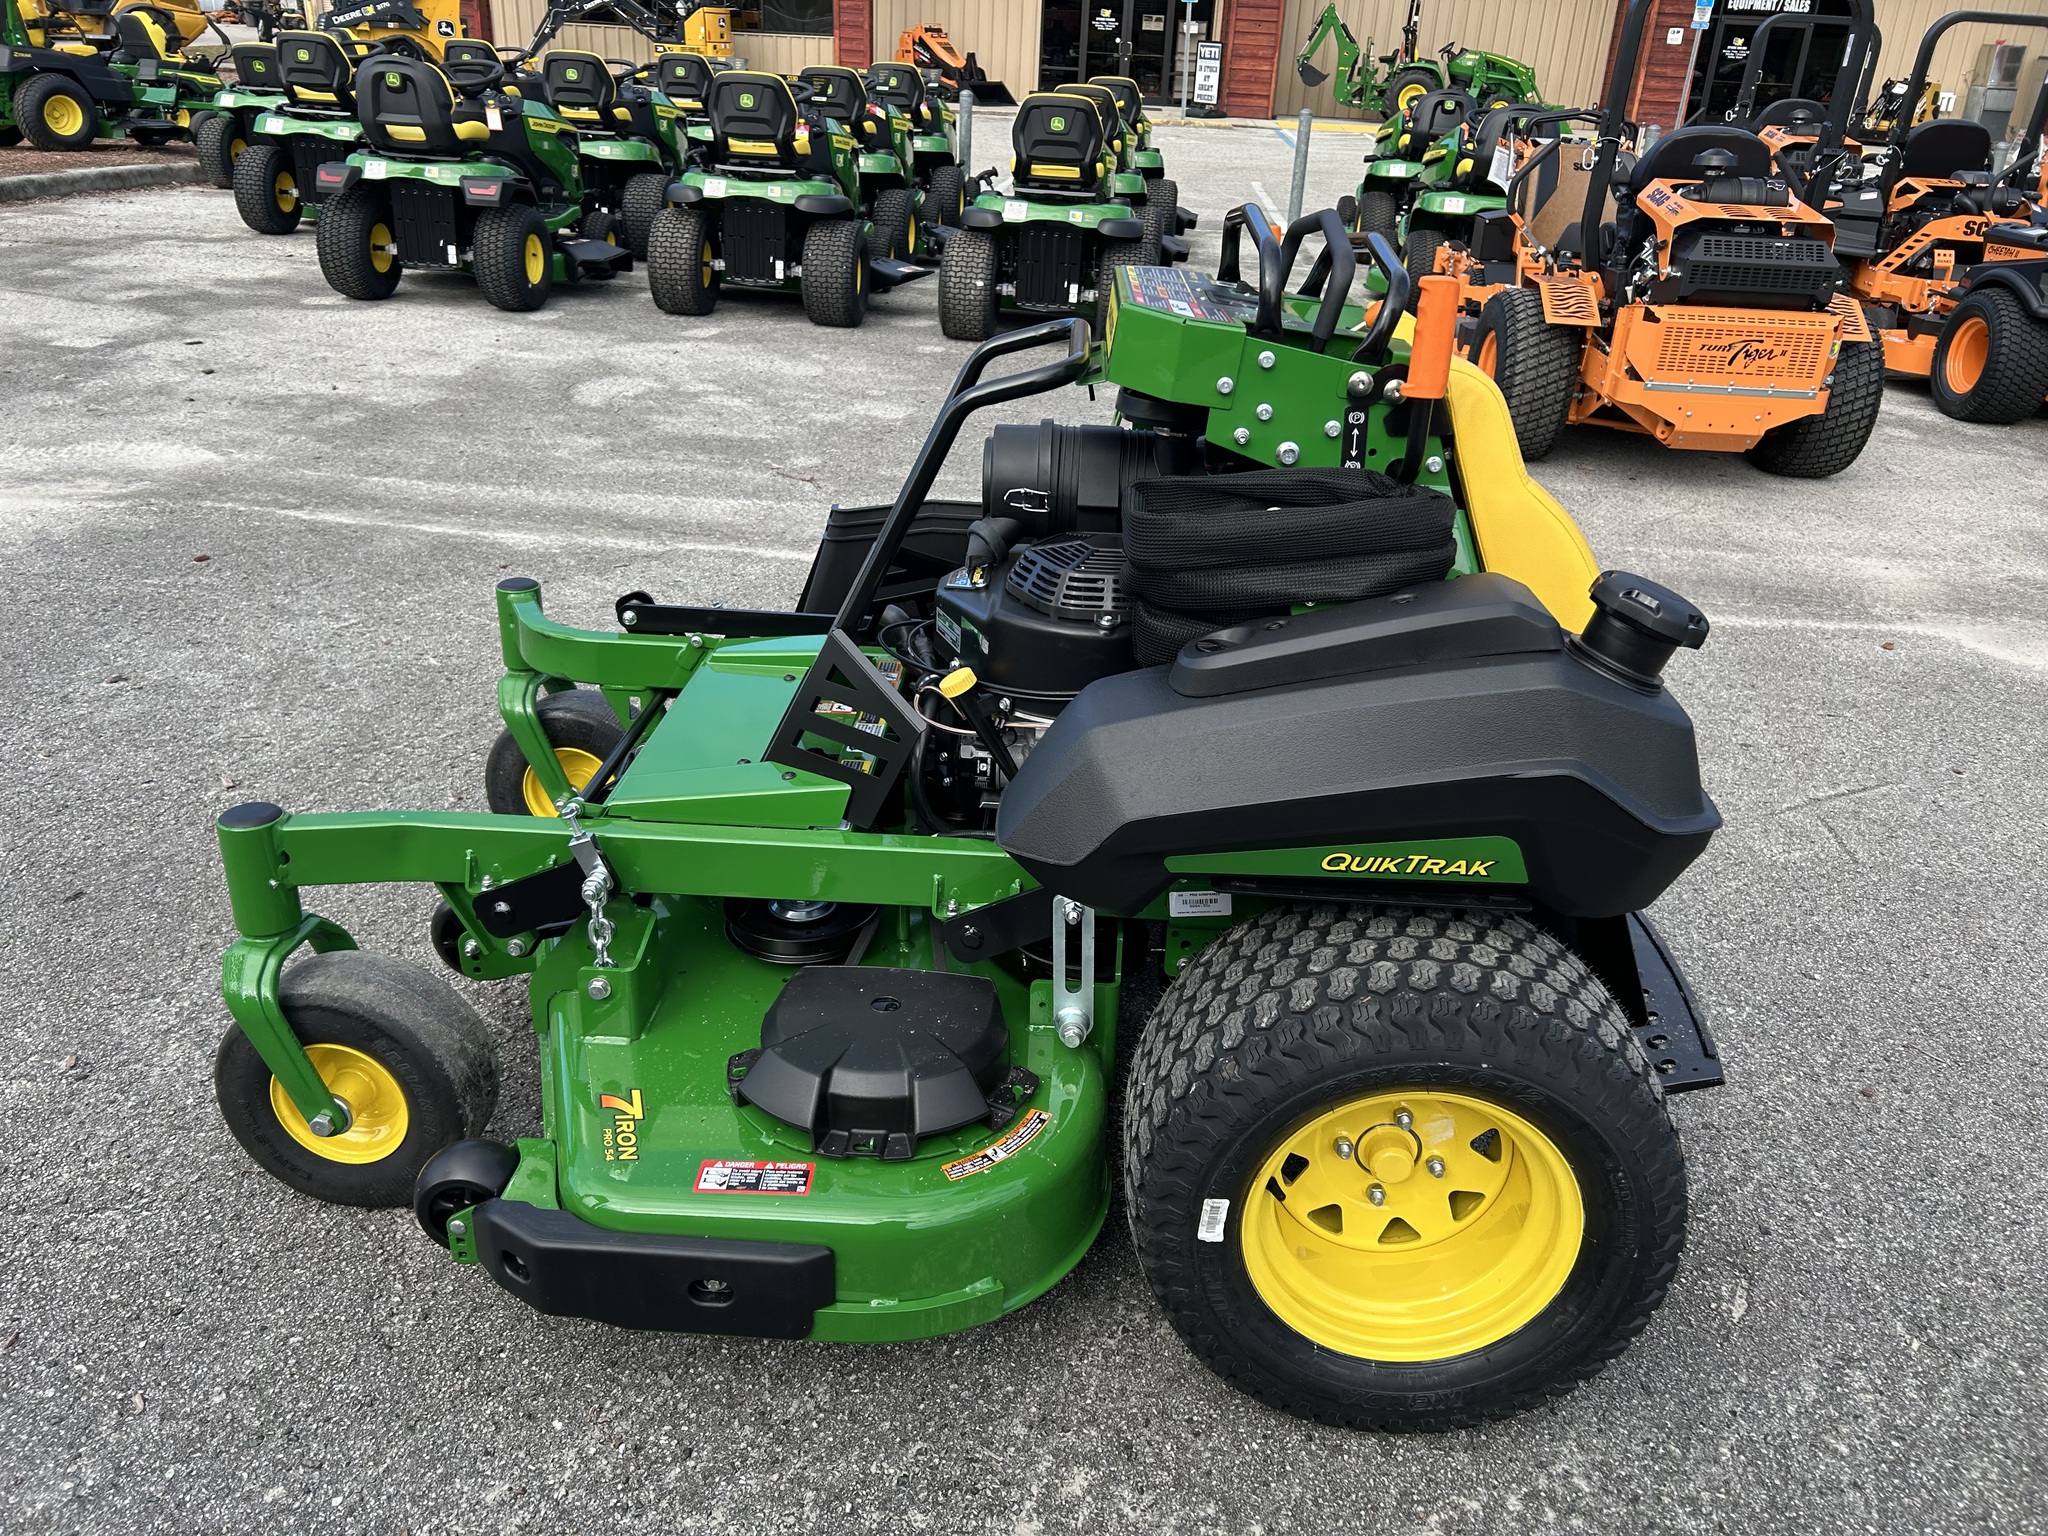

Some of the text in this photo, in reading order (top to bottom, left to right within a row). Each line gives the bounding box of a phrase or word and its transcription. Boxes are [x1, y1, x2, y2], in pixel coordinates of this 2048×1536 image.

[1728, 0, 1776, 11] EQUIPMENT
[1783, 0, 1811, 13] SALES
[332, 9, 362, 24] DEERE
[1200, 46, 1219, 58] YETI
[1646, 187, 1671, 207] SCAG
[1962, 220, 1989, 237] SC
[1988, 245, 2014, 258] CHEETAH
[1699, 343, 1736, 353] TURF
[1727, 339, 1778, 369] Tiger
[602, 1128, 615, 1161] PRO 54
